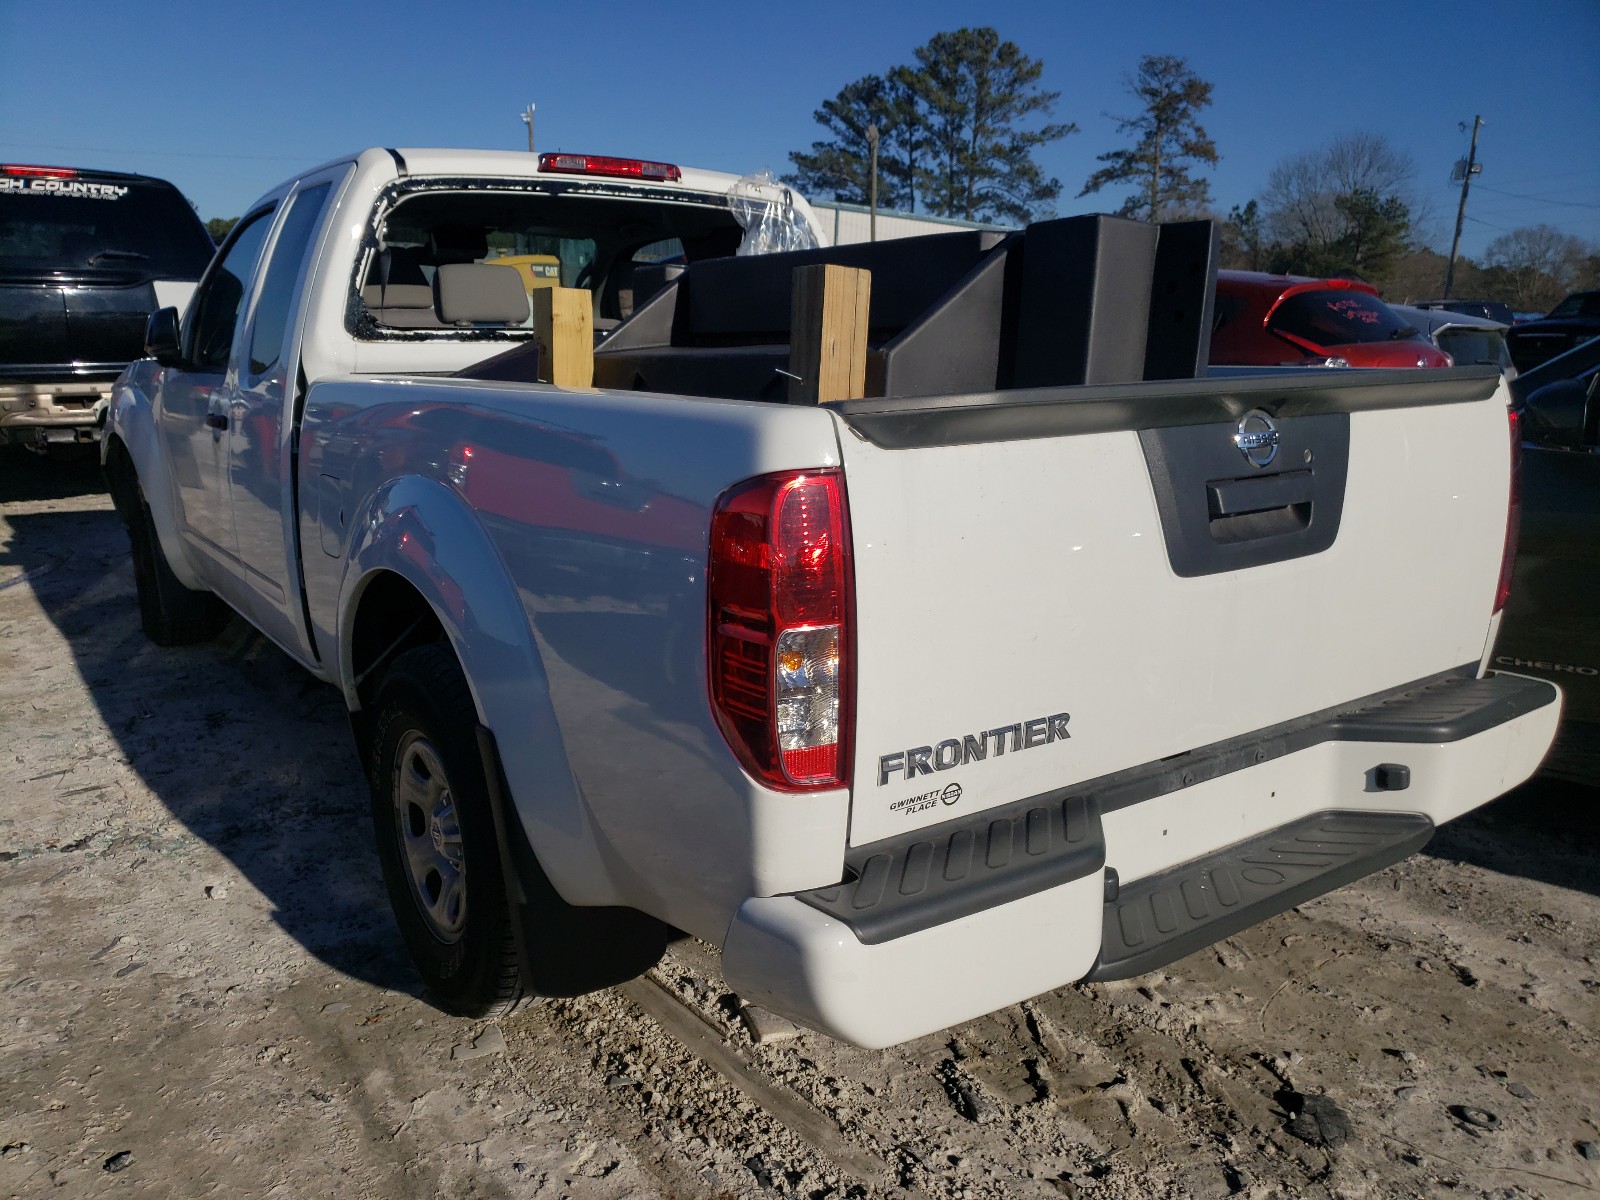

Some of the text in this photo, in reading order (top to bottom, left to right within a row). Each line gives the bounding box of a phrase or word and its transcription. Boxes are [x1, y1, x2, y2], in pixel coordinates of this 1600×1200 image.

[31, 180, 128, 197] COUNTRY
[545, 266, 558, 277] CAT
[877, 712, 1071, 787] FRONTIER
[889, 789, 942, 811] GWINNETT
[905, 800, 938, 815] PLACE
